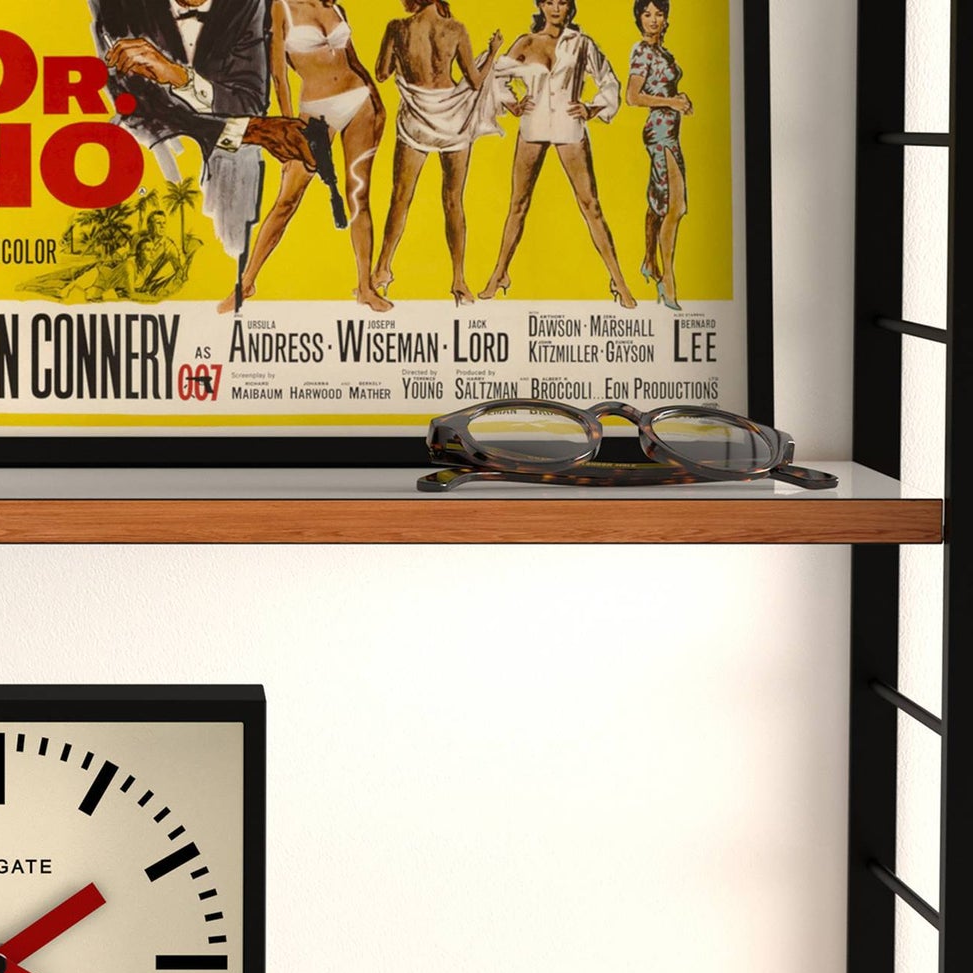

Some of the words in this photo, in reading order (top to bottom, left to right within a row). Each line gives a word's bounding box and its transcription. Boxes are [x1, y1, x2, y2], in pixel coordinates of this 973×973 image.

[247, 320, 276, 329] URSULA
[367, 320, 396, 329] JOSEPH
[467, 320, 487, 329] JACK
[528, 315, 582, 337] DAWSON
[590, 314, 655, 337] MARSHALL
[680, 319, 716, 329] BERNARD
[228, 319, 324, 363] ANDRESS
[336, 319, 439, 363] WISEMAN
[453, 319, 509, 363] LORD
[529, 340, 599, 363] KITZMILLER
[606, 340, 655, 363] GAYSON
[673, 319, 717, 362] LEE
[31, 313, 181, 399] CONNERY
[195, 346, 211, 359] AS
[177, 363, 224, 401] 007
[231, 386, 283, 400] MAIBAUM
[289, 386, 343, 400] HARWOOD
[349, 386, 391, 400] MATHER
[402, 377, 444, 399] YOUNG
[455, 377, 518, 399] SALTZMAN
[634, 377, 719, 400] PRODUCTIONS
